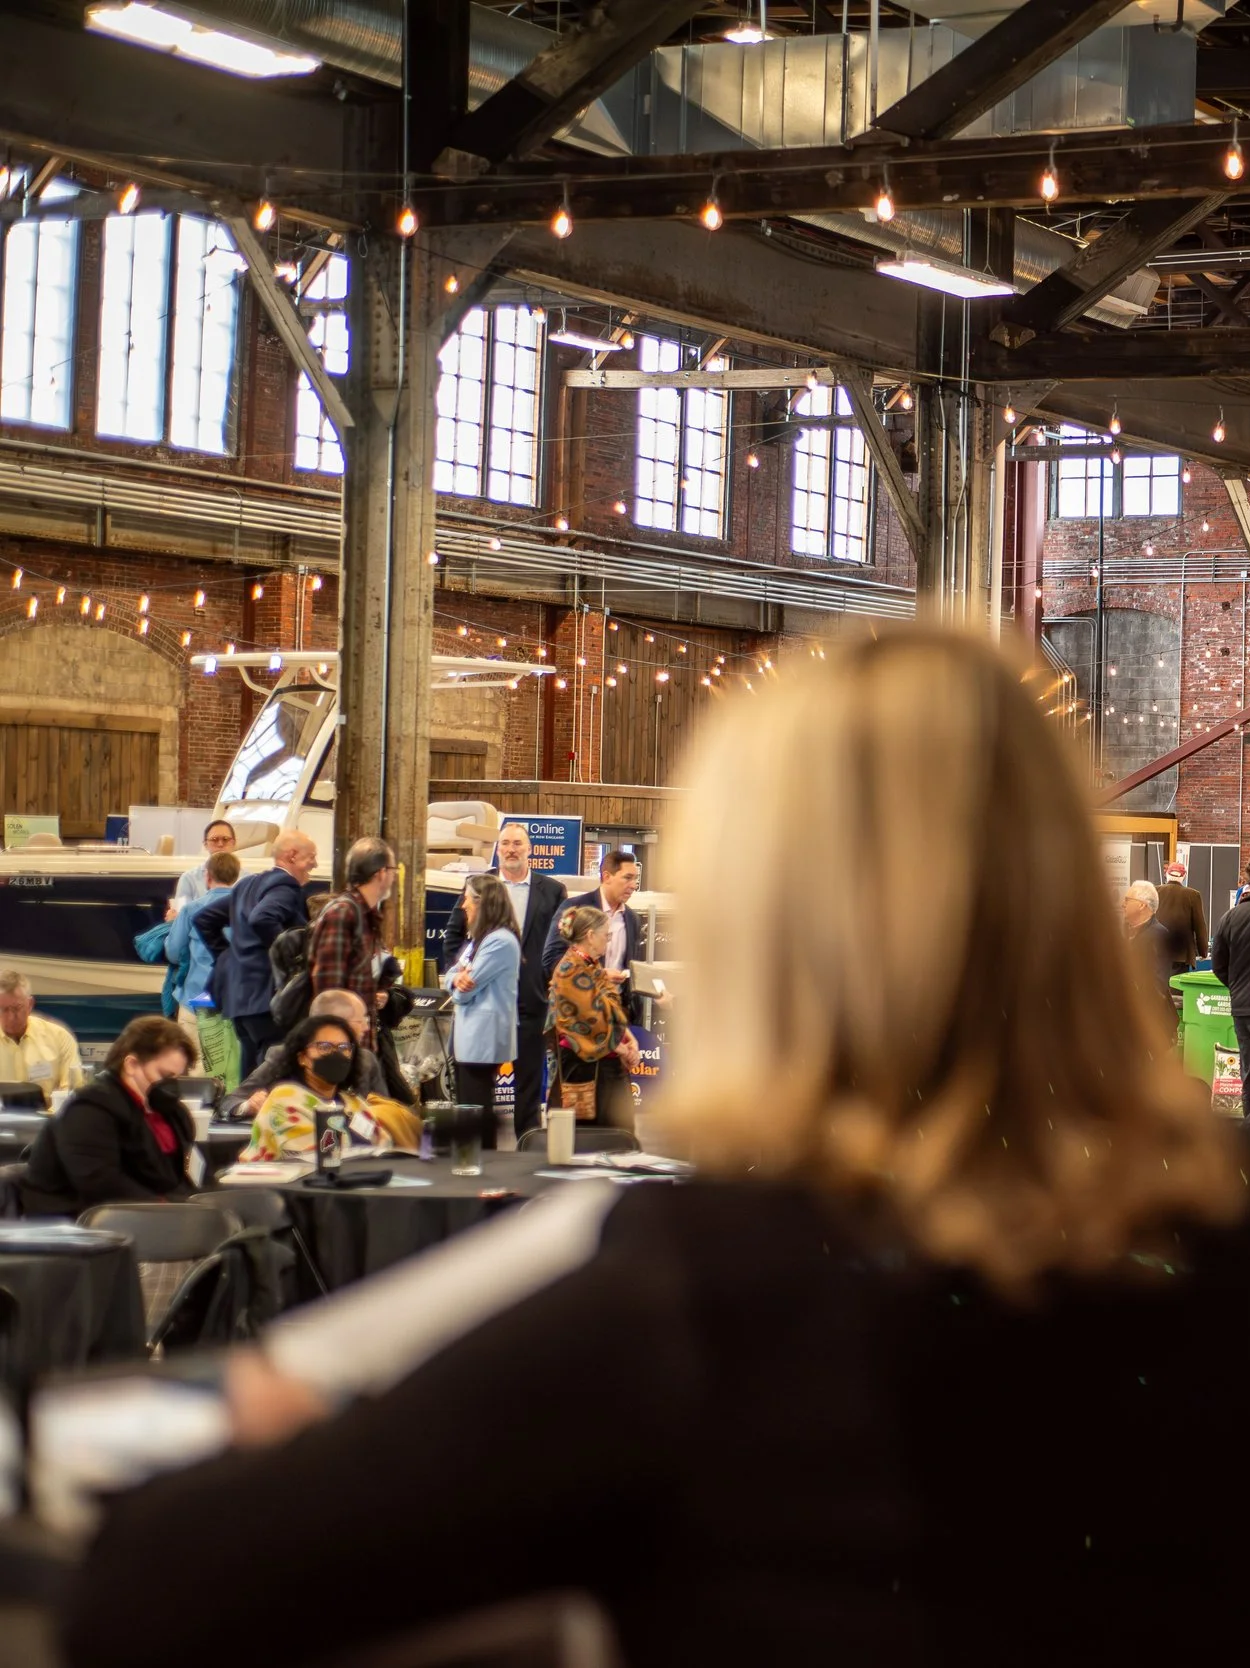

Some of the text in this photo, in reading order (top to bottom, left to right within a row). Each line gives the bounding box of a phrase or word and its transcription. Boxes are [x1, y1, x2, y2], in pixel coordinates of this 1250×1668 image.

[530, 823, 565, 834] Online
[533, 844, 566, 856] ONLINE
[639, 1046, 660, 1060] red
[630, 1061, 660, 1076] olar
[495, 1094, 515, 1102] ENER
